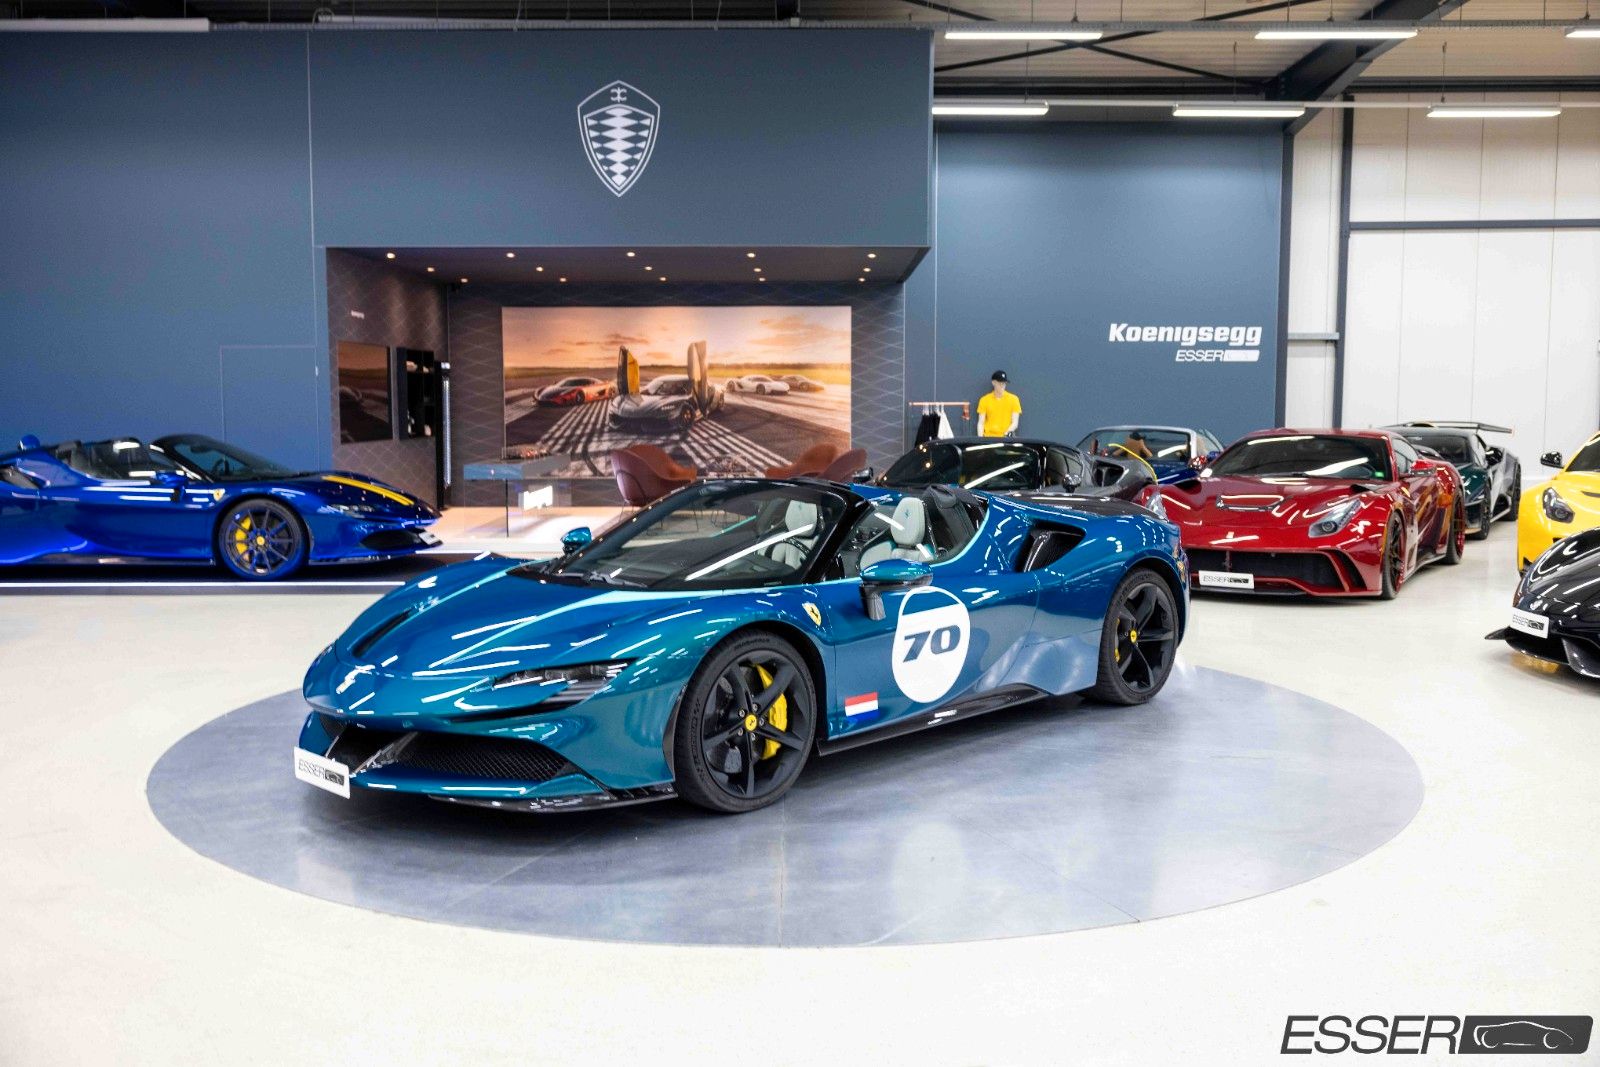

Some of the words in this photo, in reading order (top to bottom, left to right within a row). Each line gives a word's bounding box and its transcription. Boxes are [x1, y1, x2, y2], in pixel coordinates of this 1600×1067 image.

[1109, 323, 1262, 346] Koenigsegg
[1175, 349, 1224, 362] ESSER
[903, 624, 961, 663] 70
[298, 758, 325, 780] ESSER
